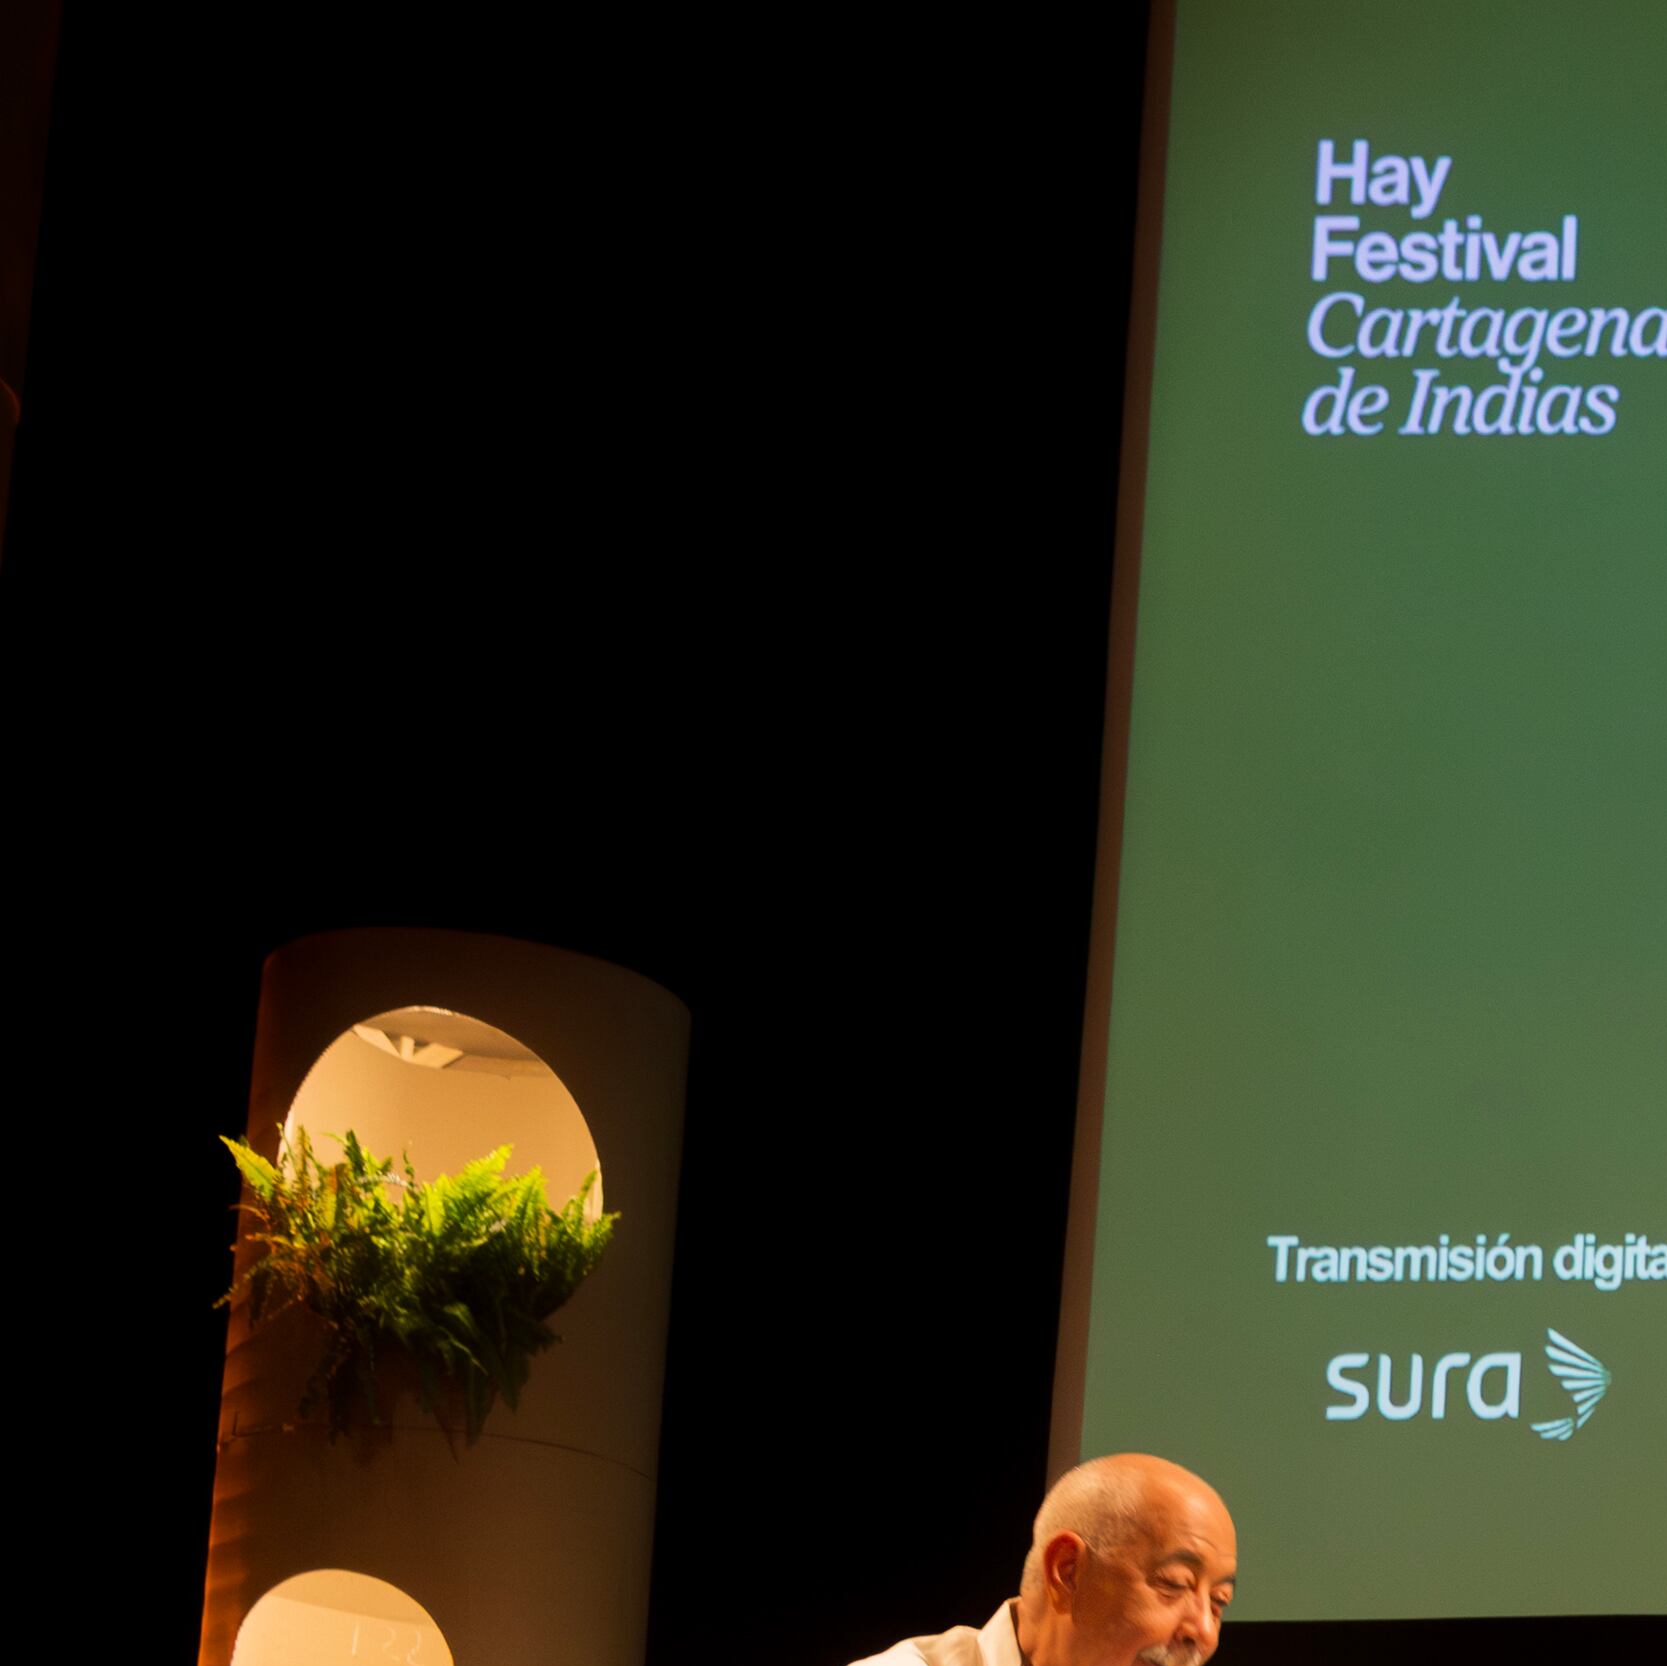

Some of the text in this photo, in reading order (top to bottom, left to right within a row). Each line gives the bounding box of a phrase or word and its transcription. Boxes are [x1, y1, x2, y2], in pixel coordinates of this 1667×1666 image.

[1315, 139, 1452, 219] Hay
[1311, 214, 1578, 283] Festival
[1301, 366, 1620, 436] de Indias
[1266, 1232, 1543, 1282] Transmisión
[1326, 1352, 1522, 1420] sura
